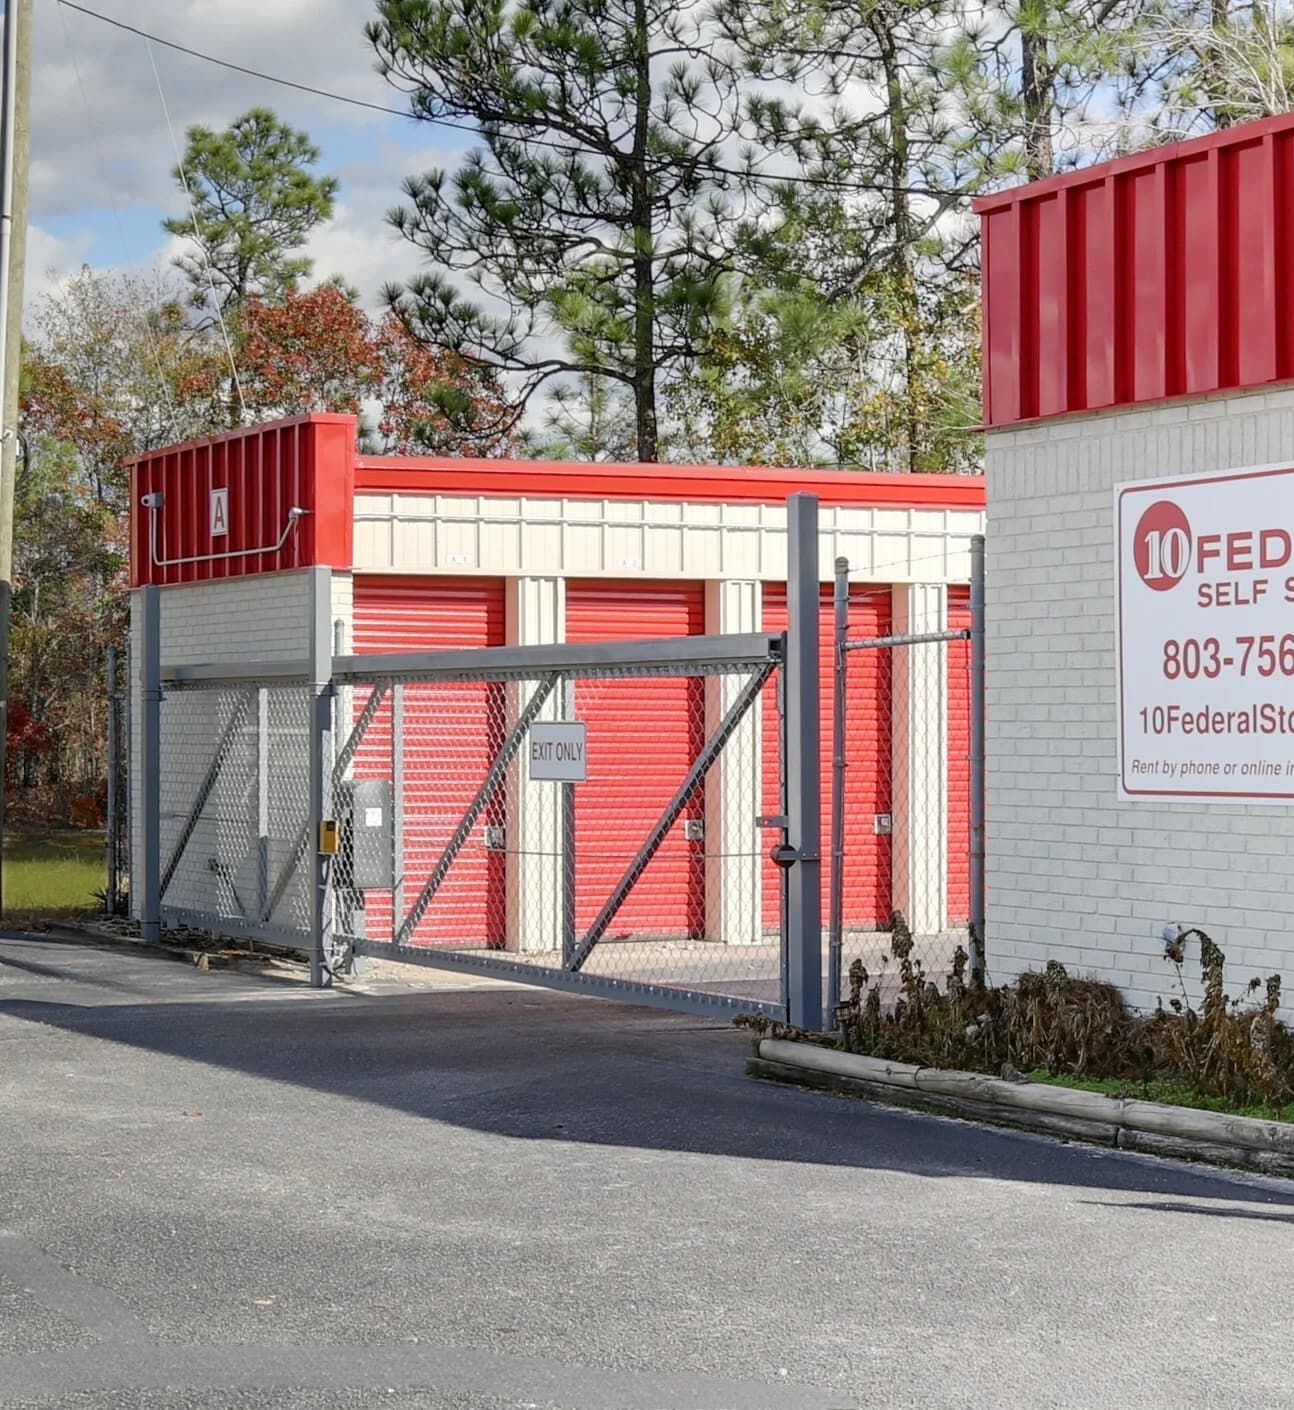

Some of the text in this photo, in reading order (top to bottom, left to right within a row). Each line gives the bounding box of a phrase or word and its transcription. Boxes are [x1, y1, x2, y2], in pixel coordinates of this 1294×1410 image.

[214, 496, 225, 529] A
[1143, 527, 1191, 580] 10
[1197, 579, 1268, 608] SELF
[532, 742, 583, 762] EXIT ONLY
[1131, 760, 1158, 774] Rent
[1162, 760, 1177, 777] by
[1180, 760, 1220, 777] phone
[1224, 763, 1237, 775] or
[1241, 760, 1281, 775] online
